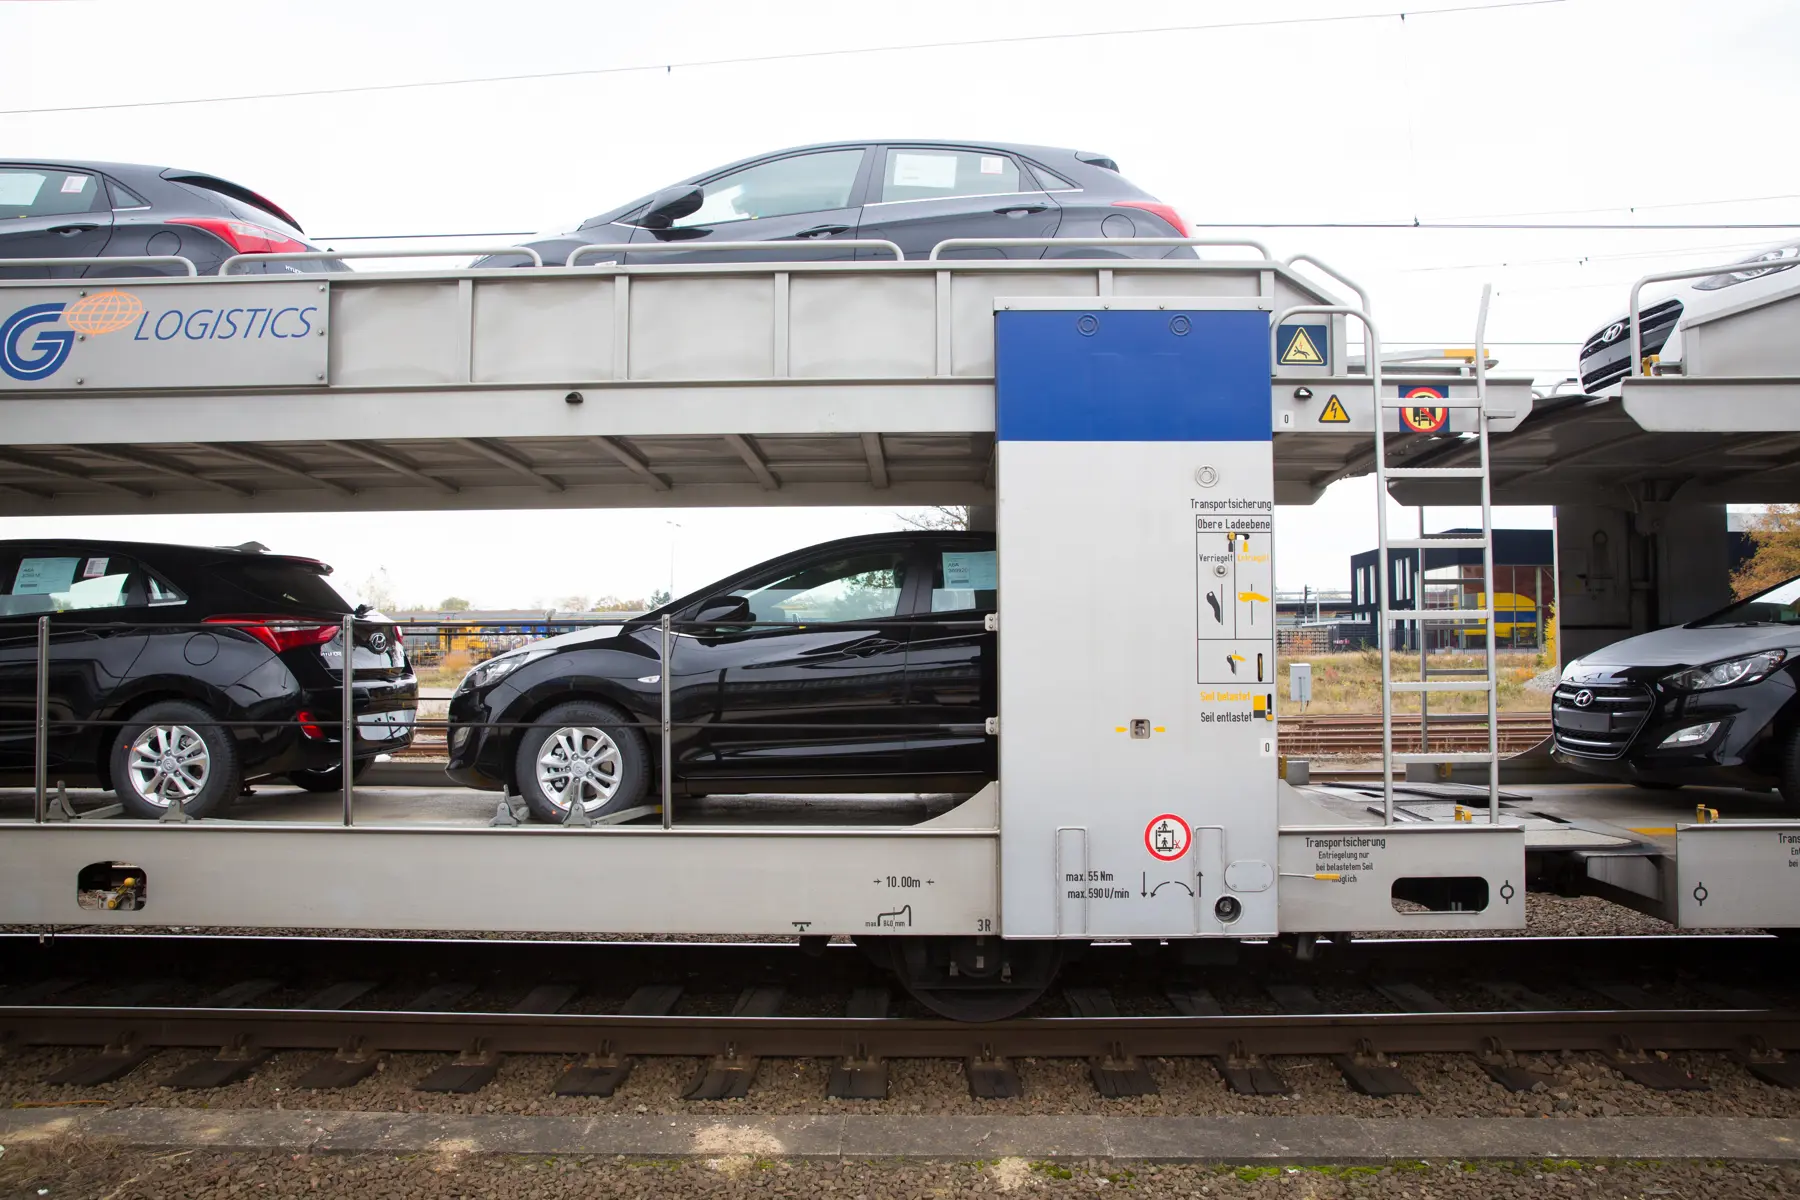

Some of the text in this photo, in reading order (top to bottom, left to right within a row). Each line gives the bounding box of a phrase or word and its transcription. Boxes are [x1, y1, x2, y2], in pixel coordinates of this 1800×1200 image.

[133, 307, 318, 341] LOGISTICS
[1190, 498, 1272, 511] Transportsicherung
[1197, 518, 1271, 529] Obere Ladeebene
[1199, 553, 1233, 564] Verriegelt
[1200, 690, 1251, 702] Seil belastet
[1200, 711, 1253, 722] Seil entlastet
[1305, 837, 1386, 849] Transportsicherung
[1318, 851, 1358, 860] Entriegelung
[1315, 862, 1374, 871] bei belastetem Seil
[1788, 859, 1799, 868] bei
[1065, 871, 1114, 881] max. 55 Nm
[886, 876, 921, 888] 10.00m
[1067, 890, 1087, 899] max.
[977, 919, 992, 932] 3R
